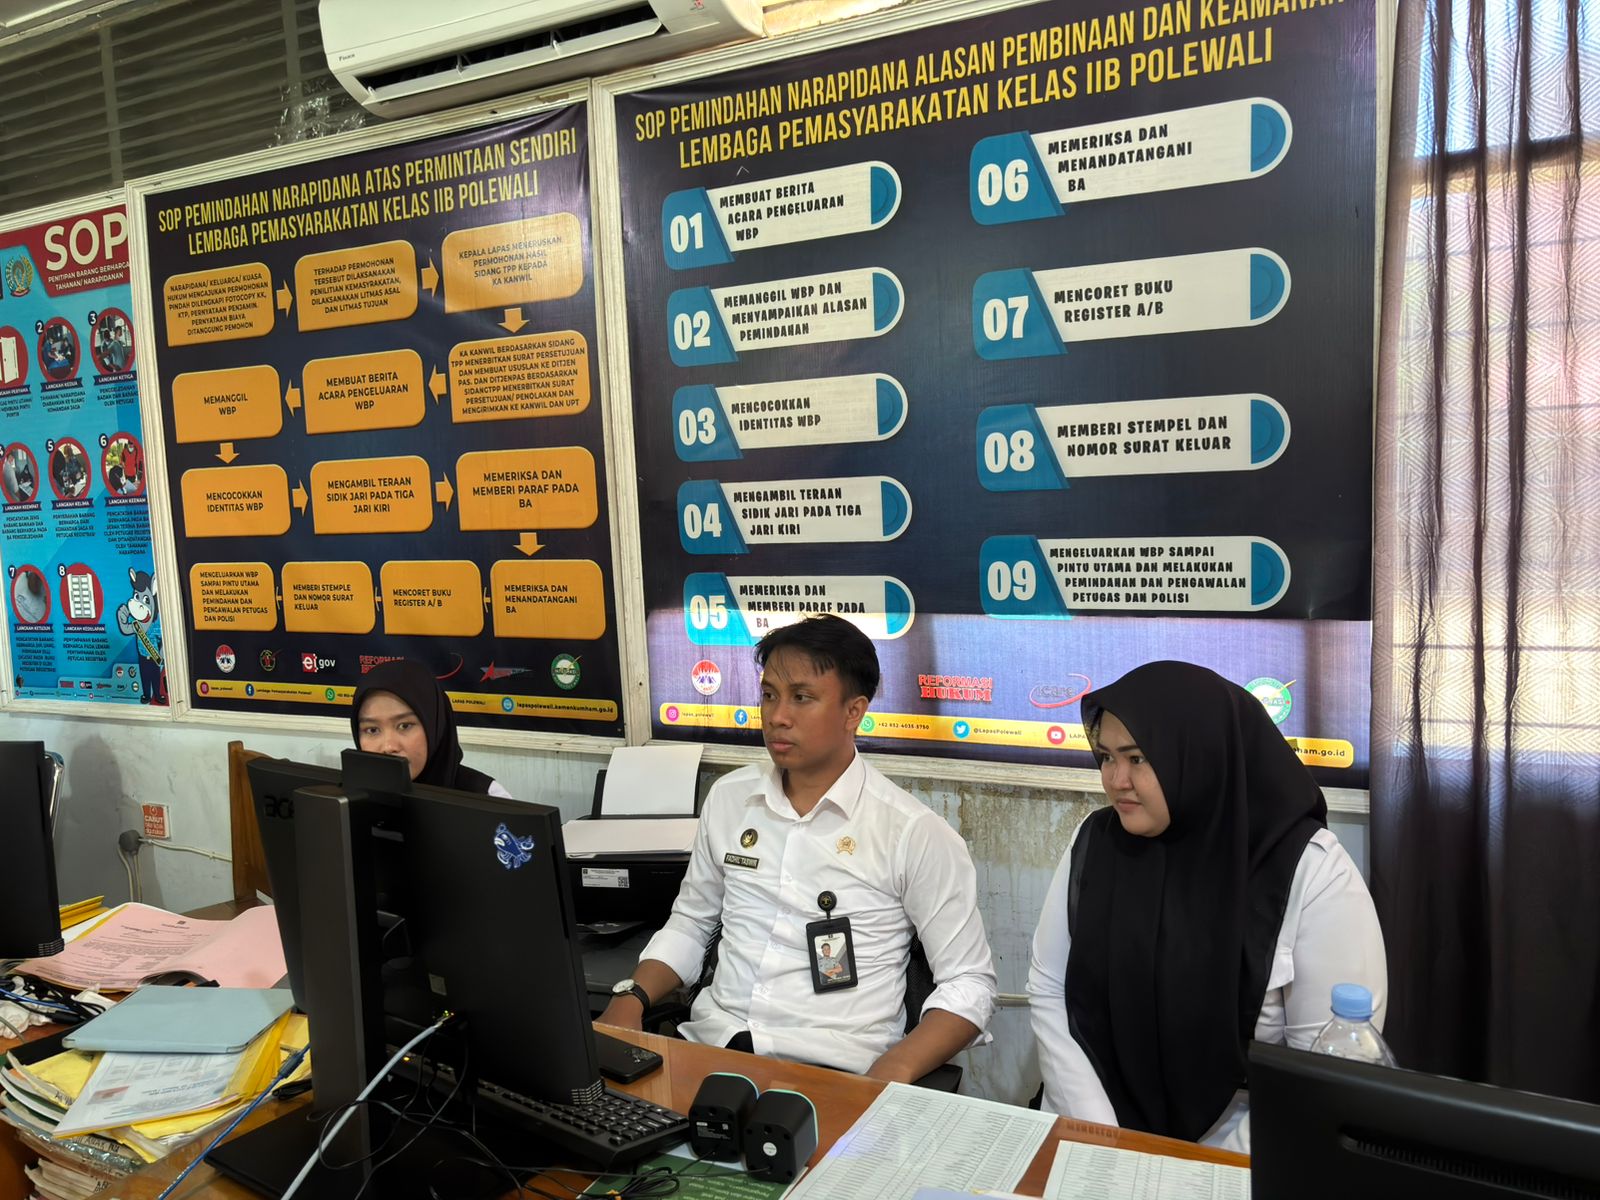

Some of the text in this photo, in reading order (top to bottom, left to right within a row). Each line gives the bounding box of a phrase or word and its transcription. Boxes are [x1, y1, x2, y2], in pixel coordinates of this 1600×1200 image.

[635, 0, 1344, 141] SOP PEMINDAHAN NARAPIDANA ALASAN PEMBINAAN DAN KEAM
[680, 27, 1272, 168] LEMBAGA PEMASYARAKATAN KELAS IIB POLEWALI
[1048, 124, 1168, 155] MEMERIKSA DAN
[1058, 142, 1192, 174] MENANDATANGANI
[159, 128, 576, 232] SOP PEMINDAHAN NARAPIDANA ATAS PERMINTAAN SENDIRI
[977, 159, 1029, 206] 06
[1068, 178, 1086, 192] BA
[720, 182, 815, 208] MEMBUAT BERITA
[189, 170, 538, 255] LEMBAGA PEMASYARAKATAN KELAS IIB POLEWALI
[728, 195, 844, 224] ACARA PENGELUARAN
[670, 213, 704, 253] 01
[736, 228, 759, 241] WBP
[44, 212, 128, 271] SOP
[314, 258, 394, 275] TERHADAP PERMOHONAN
[49, 272, 75, 283] PENITIPAN
[77, 269, 99, 278] BARANG
[243, 273, 262, 284] KUASA
[724, 282, 842, 308] MEMANGGIL WBP DAN
[1054, 280, 1173, 304] MENCORET BUKU
[732, 298, 867, 324] MENYAMPAIKAN ALASAN
[983, 295, 1029, 341] 07
[1064, 302, 1164, 323] REGISTER A/B
[90, 314, 96, 324] 3
[37, 322, 43, 332] 2
[674, 310, 711, 350] 02
[740, 323, 809, 341] PEMINDAHAN
[470, 348, 494, 356] KANWIL
[497, 343, 546, 354] BERDASARKAN
[548, 339, 575, 347] SIDANG
[465, 356, 511, 367] MENERBITKAN
[513, 353, 534, 362] SURAT
[536, 348, 585, 359] PERSETUJUAN
[327, 372, 398, 386] MEMBUAT BERITA
[204, 394, 248, 404] MEMANGGIL
[319, 384, 408, 400] ACARA PENGELUARAN
[219, 407, 236, 415] WBP
[355, 401, 374, 410] WBP
[732, 397, 810, 414] MENCOCOKKAN
[679, 407, 717, 446] 03
[739, 415, 821, 431] IDENTITAS WBP
[1057, 416, 1227, 438] MEMBERI STEMPEL DAN
[48, 441, 53, 451] 5
[101, 436, 106, 446] 6
[1067, 437, 1231, 457] NOMOR SURAT KELUAR
[984, 430, 1035, 473] 08
[328, 477, 411, 488] MENGAMBIL TERAAN
[484, 470, 562, 482] MEMERIKSA DAN
[206, 491, 263, 501] MENCOCOKKAN
[327, 490, 414, 501] SIDIK JARI PADA TIGA
[473, 484, 579, 496] MEMBERI PARAF PADA
[734, 488, 842, 503] MENGAMBIL TERAAN
[207, 503, 263, 512] IDENTITAS WBP
[354, 504, 390, 513] JARI KIRI
[519, 499, 532, 508] BA
[742, 505, 861, 519] SIDIK JARI PADA TIGA
[684, 503, 722, 539] 04
[750, 524, 800, 535] JARI KIRI
[1050, 546, 1214, 558] MENGELUARKAN WBP SAMPAI
[10, 568, 15, 577] 7
[59, 566, 65, 575] 8
[1058, 562, 1233, 573] PINTU UTAMA DAN MELAKUKAN
[987, 560, 1036, 601] 09
[1065, 577, 1246, 588] PEMINDAHAN DAN PENGAWALAN
[740, 585, 826, 596] MEMERIKSA DAN
[1073, 592, 1189, 603] PETUGAS DAN POLISI
[690, 595, 728, 630] 05
[748, 601, 865, 613] MEMBERI PARAF PADA
[756, 617, 769, 628] BA
[919, 674, 992, 689] REFORMASI
[921, 686, 992, 701] HUKUM
